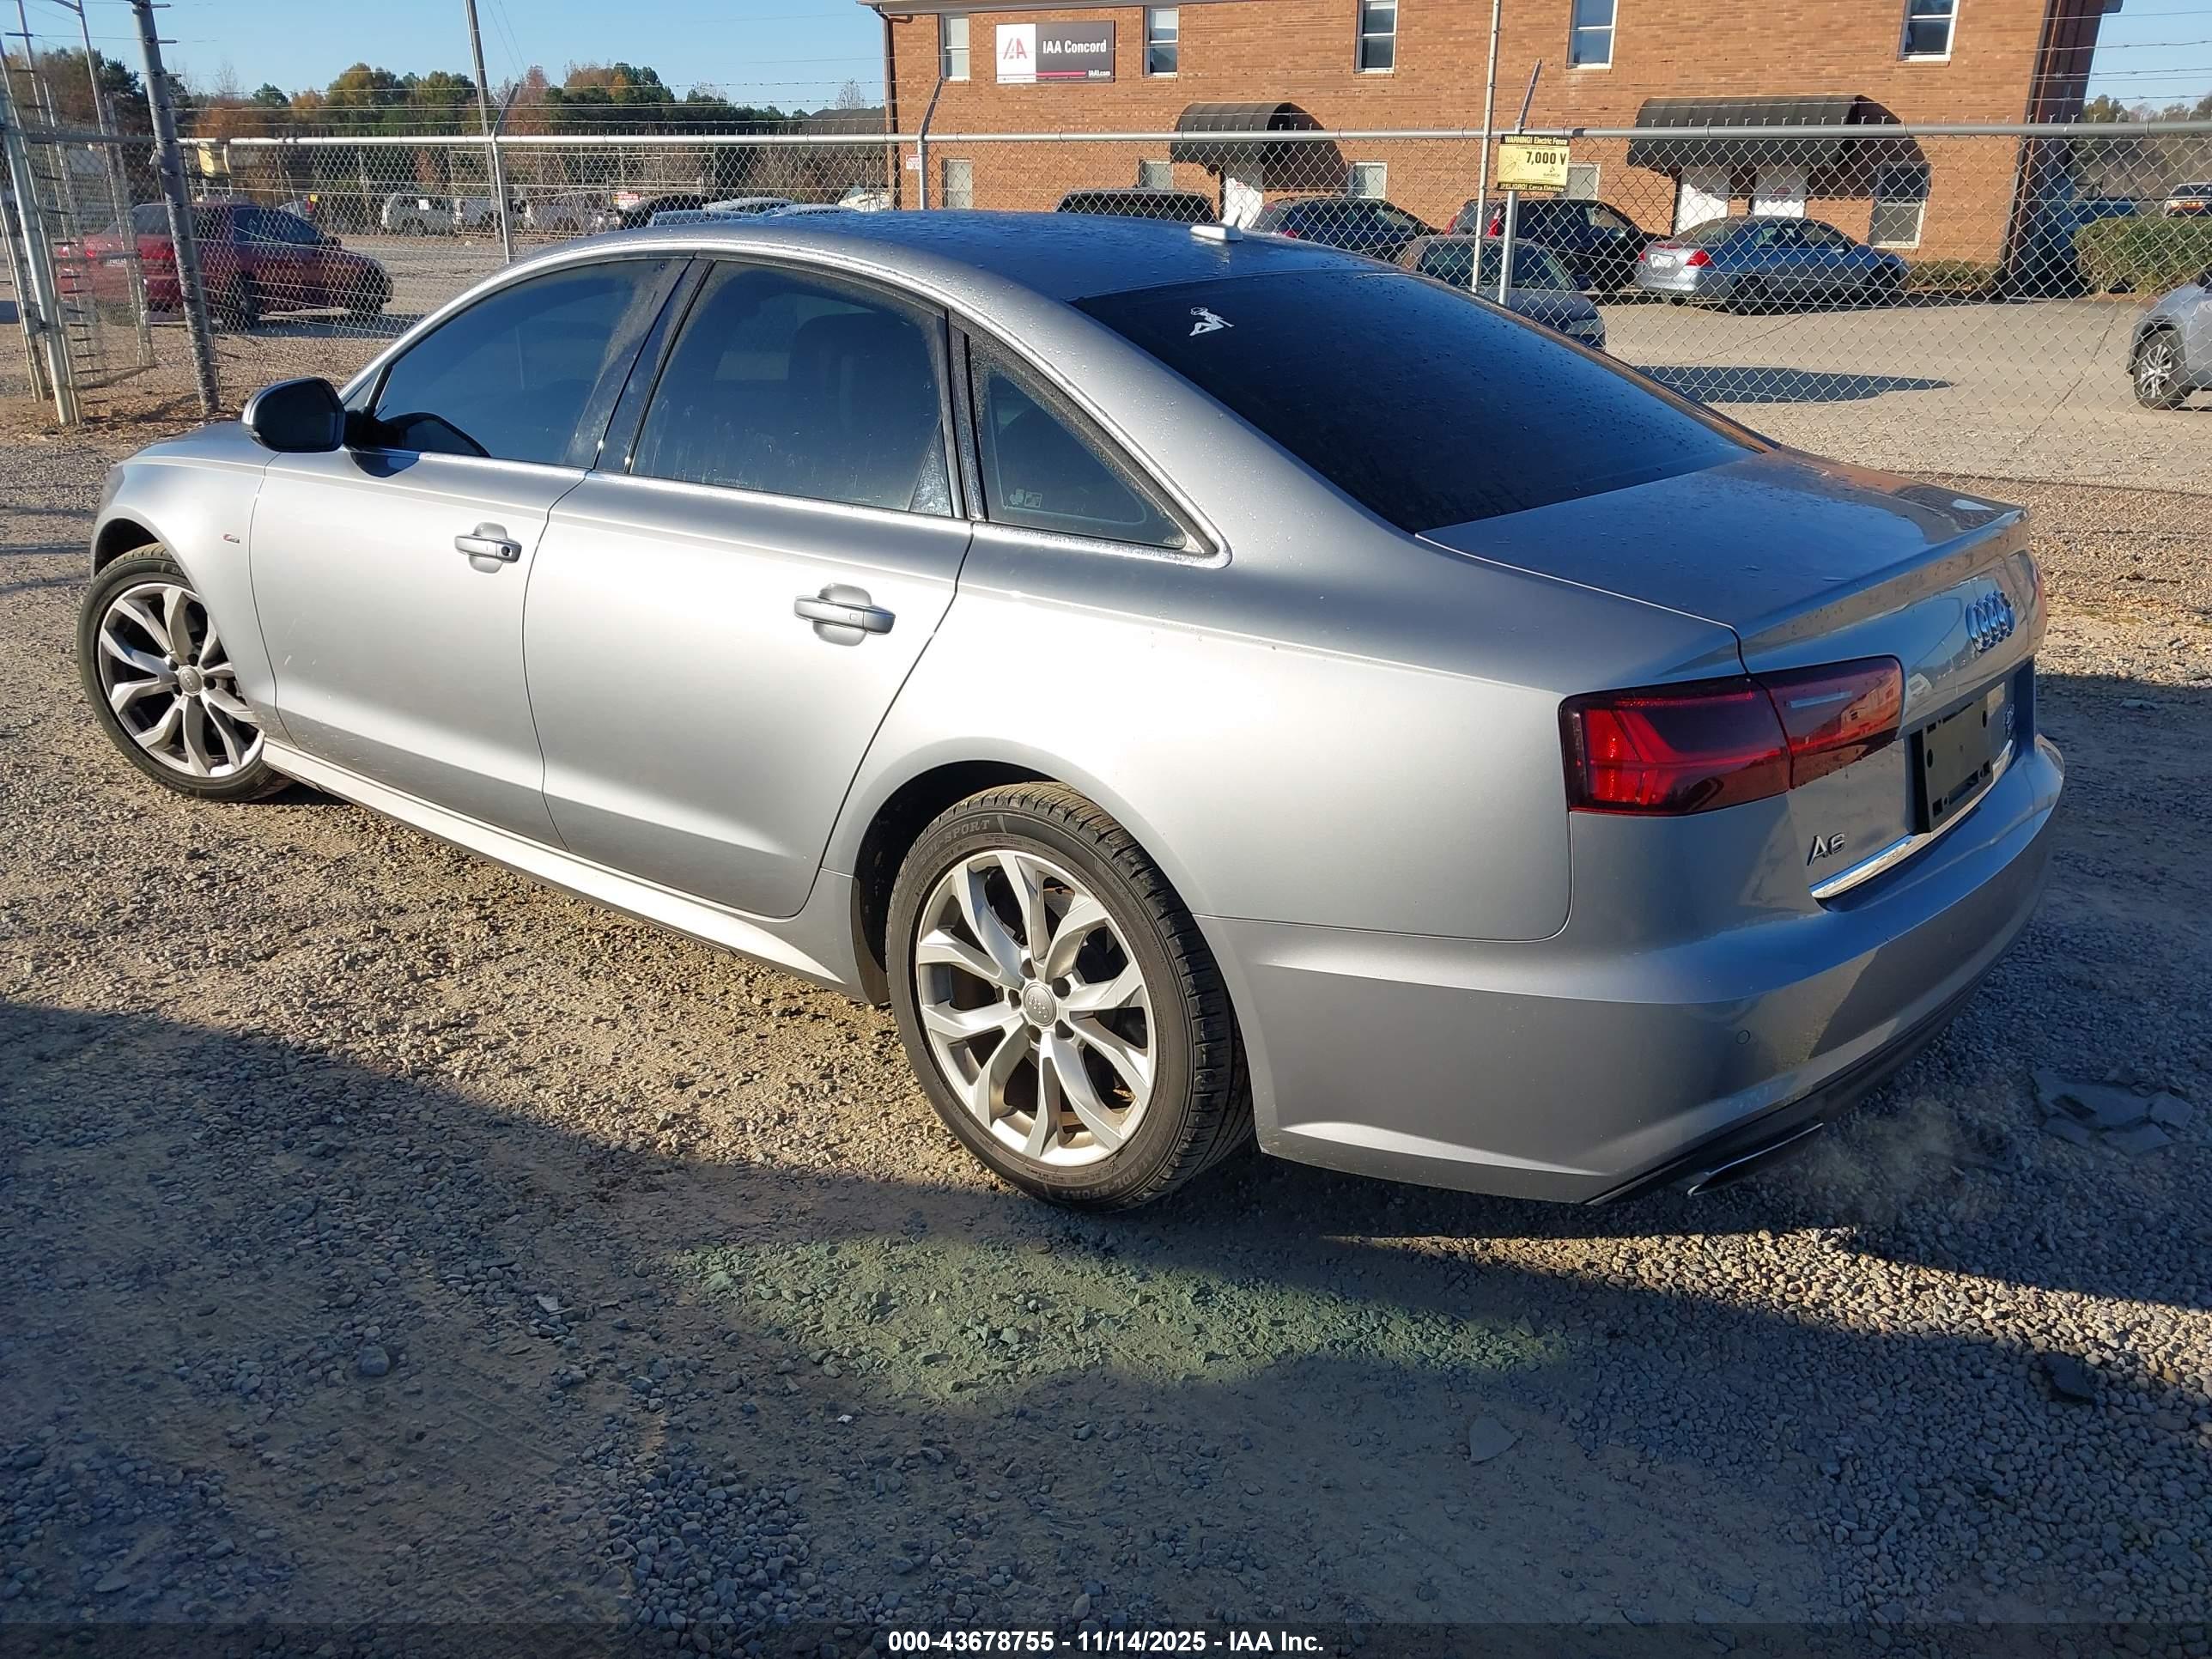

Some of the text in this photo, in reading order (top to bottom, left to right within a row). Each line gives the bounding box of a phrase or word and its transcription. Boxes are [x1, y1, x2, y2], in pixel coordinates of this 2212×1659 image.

[1042, 39, 1107, 54] IAA Concord
[1504, 135, 1533, 144] WARNING!
[1534, 136, 1553, 144] Electric
[1526, 151, 1566, 165] 7,000 V
[1807, 832, 1845, 866] A6
